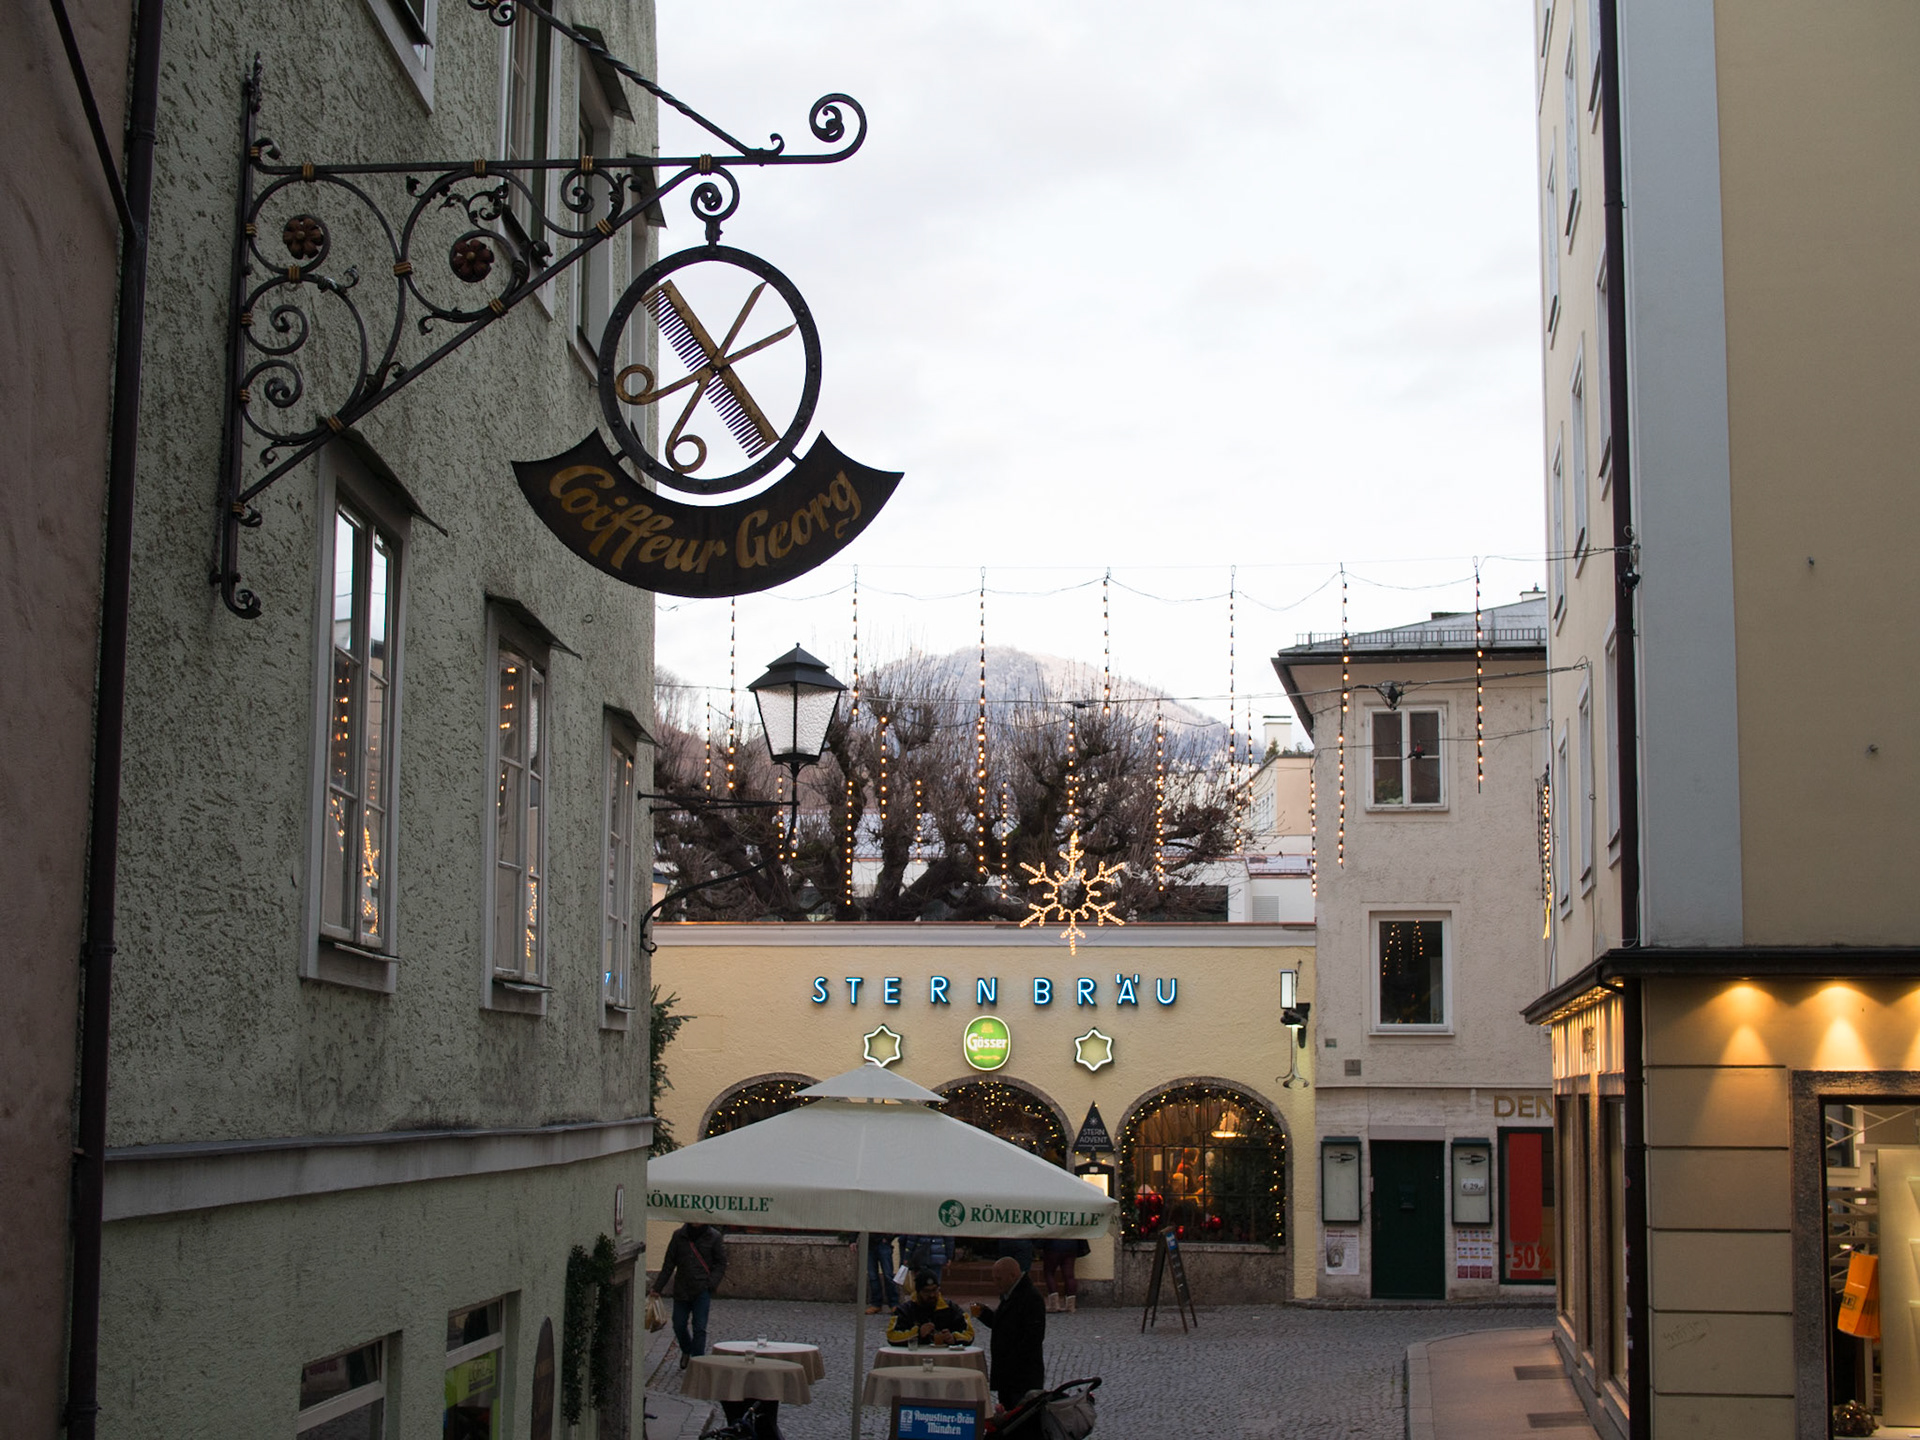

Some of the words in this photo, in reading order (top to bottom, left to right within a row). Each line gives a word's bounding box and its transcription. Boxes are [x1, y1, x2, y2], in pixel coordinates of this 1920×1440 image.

[549, 465, 727, 573] Coiffeur
[735, 470, 863, 568] Georg
[967, 1033, 1007, 1051] Gösser
[1080, 1136, 1107, 1144] ADVENT
[1082, 1128, 1105, 1136] STERN
[970, 1204, 1100, 1228] RÖMERQUELLE
[1505, 1244, 1552, 1270] -50%
[927, 1422, 962, 1435] München
